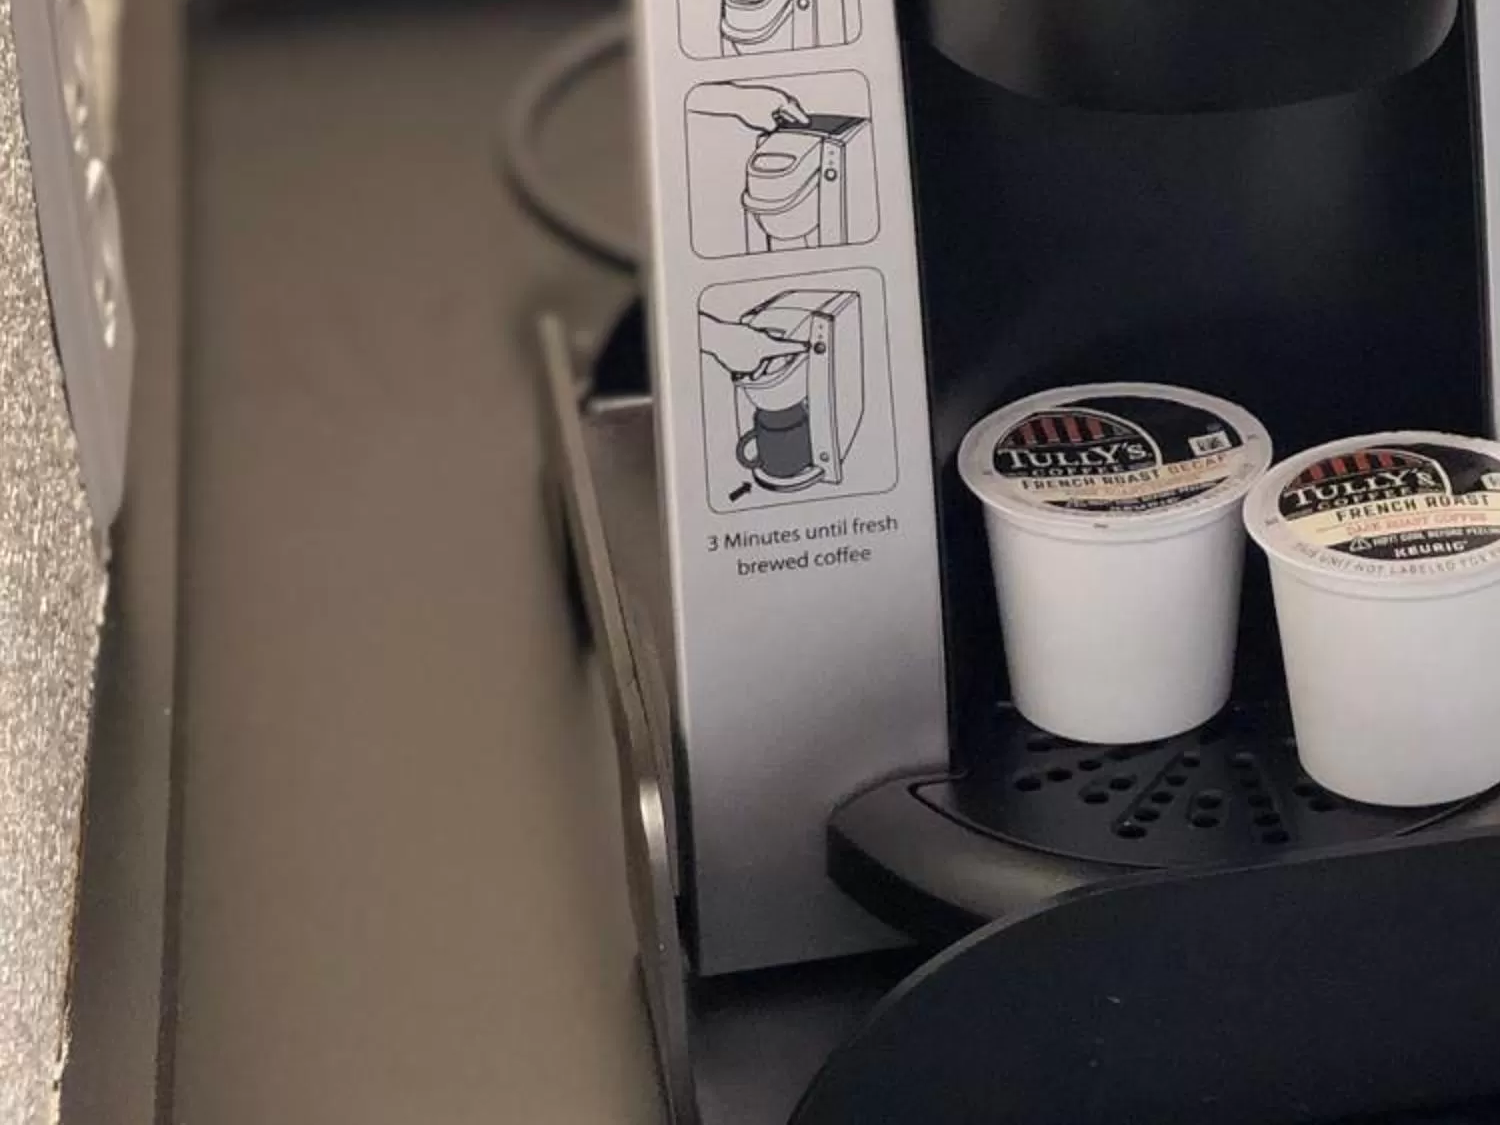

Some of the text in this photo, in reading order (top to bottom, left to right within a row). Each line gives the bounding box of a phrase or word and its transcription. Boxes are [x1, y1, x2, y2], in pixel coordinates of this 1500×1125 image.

[1022, 454, 1226, 490] FRENCH ROAST DECAF
[1031, 463, 1121, 476] COFFEE
[1318, 486, 1413, 511] COFFEE
[1336, 493, 1490, 523] FRENCH ROAST
[706, 514, 899, 552] 3 Minutes until fresh
[736, 545, 873, 576] brewed coffee
[1394, 540, 1466, 558] KEURIG
